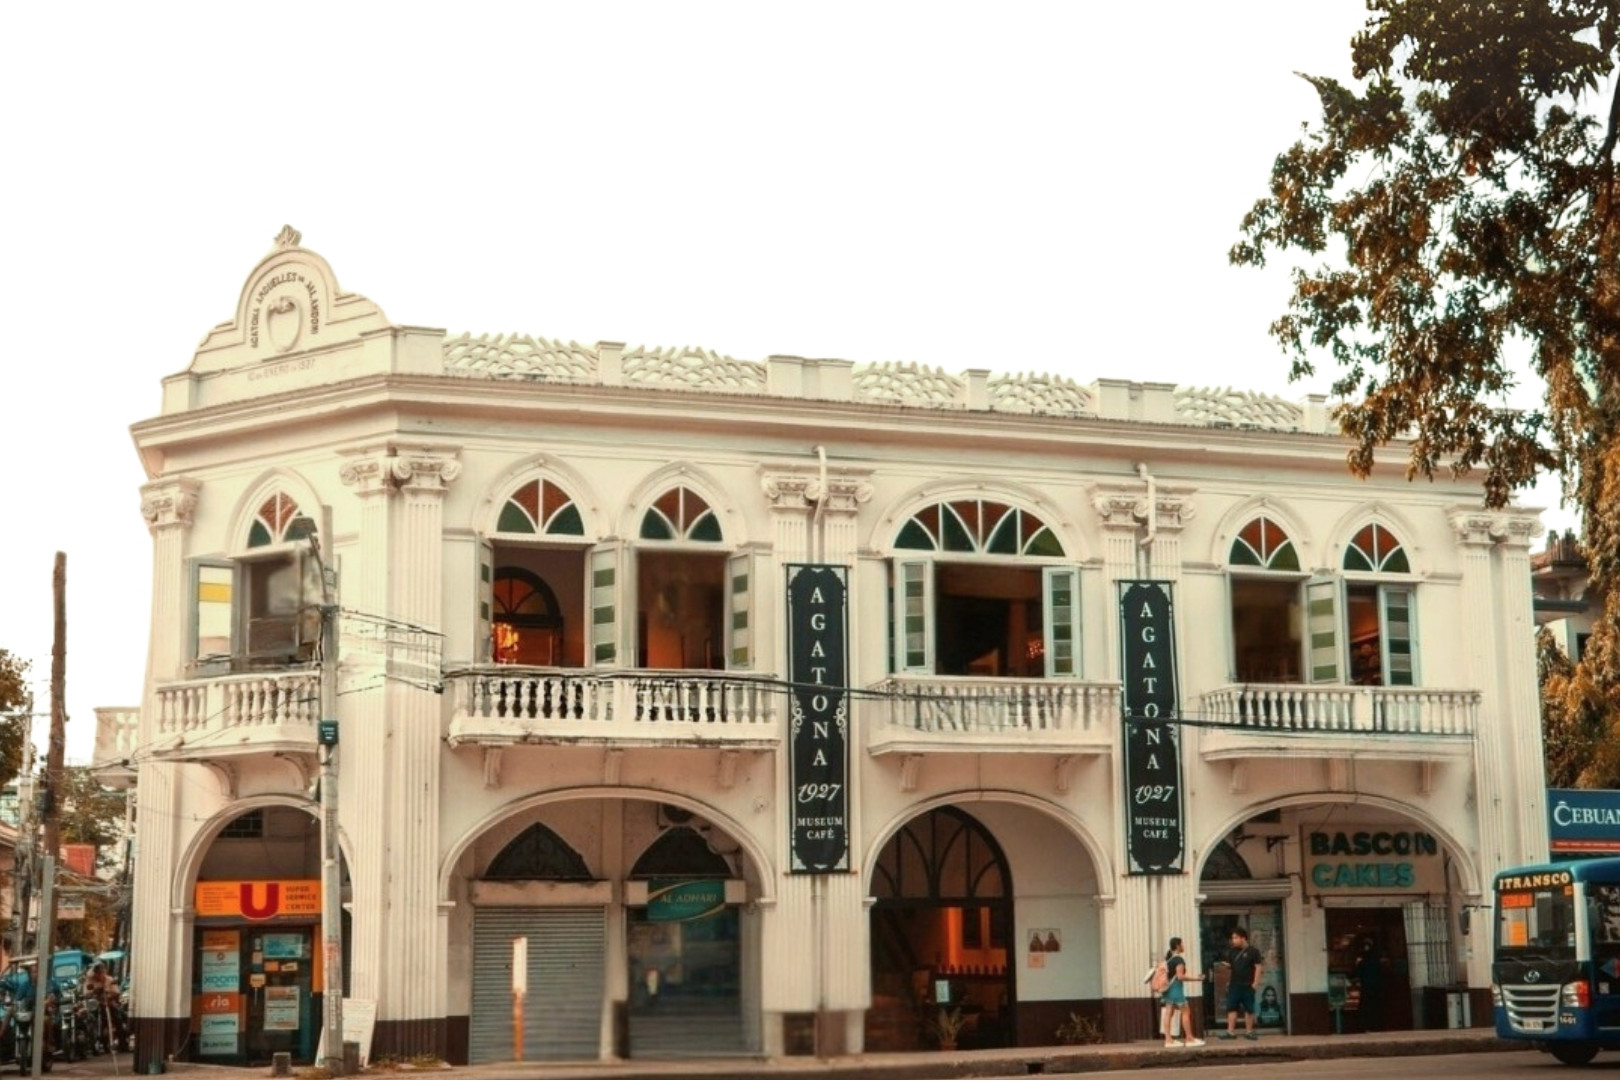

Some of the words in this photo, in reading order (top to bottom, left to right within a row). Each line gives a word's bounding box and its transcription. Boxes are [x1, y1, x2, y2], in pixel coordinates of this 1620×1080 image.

[810, 586, 829, 766] AGATONA
[1140, 601, 1161, 770] AGATONA
[798, 783, 842, 803] 1927
[1135, 785, 1175, 804] 1927
[797, 816, 843, 827] MUSEUM
[1135, 816, 1177, 827] MUSEUM
[806, 827, 835, 841] CAFÉ
[1142, 828, 1169, 840] CAFÉ
[1310, 831, 1437, 856] BASCON
[1312, 862, 1415, 888] CAKES
[240, 883, 279, 918] U
